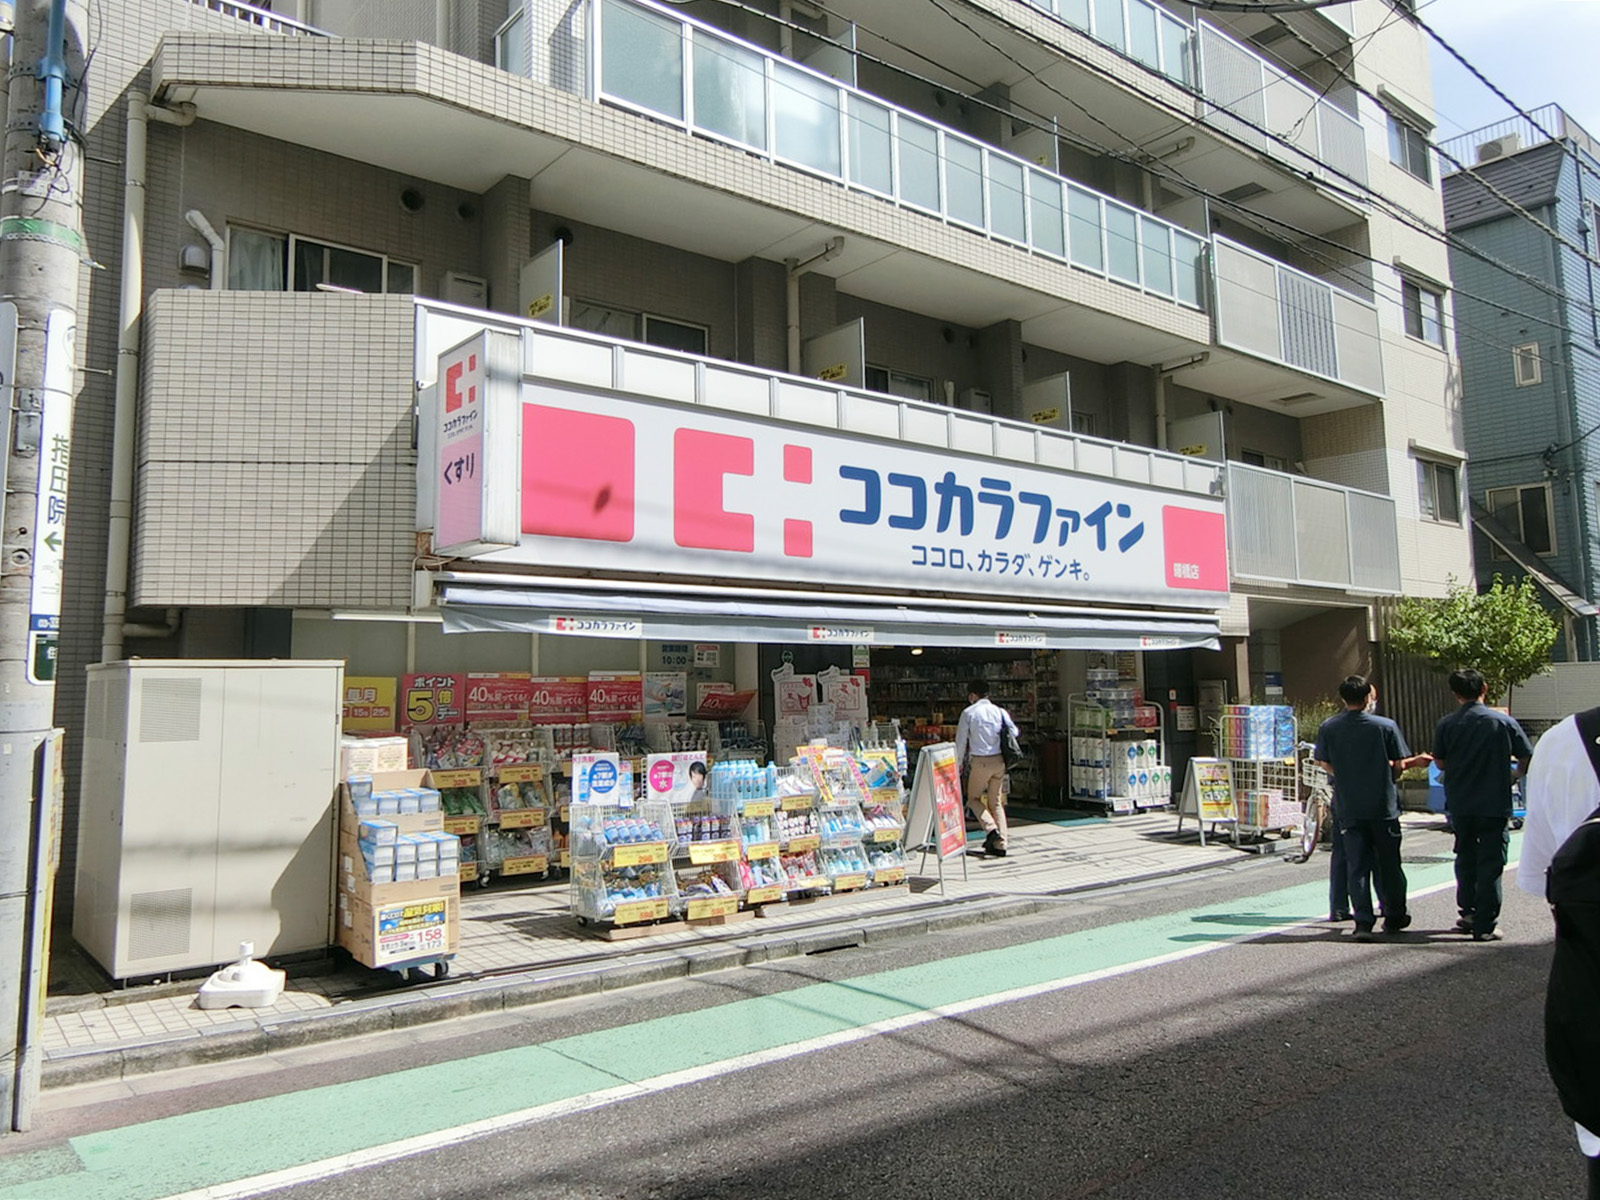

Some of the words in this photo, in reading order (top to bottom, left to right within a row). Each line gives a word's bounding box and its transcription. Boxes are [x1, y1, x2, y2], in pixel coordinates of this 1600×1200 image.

[443, 452, 475, 485] くすり
[839, 464, 1145, 553] ココカラファイン
[911, 544, 1090, 581] ココロ、カラダ、ゲンキ。
[577, 620, 637, 631] ココカラファイン
[414, 677, 455, 688] ポイント
[416, 929, 442, 942] 158
